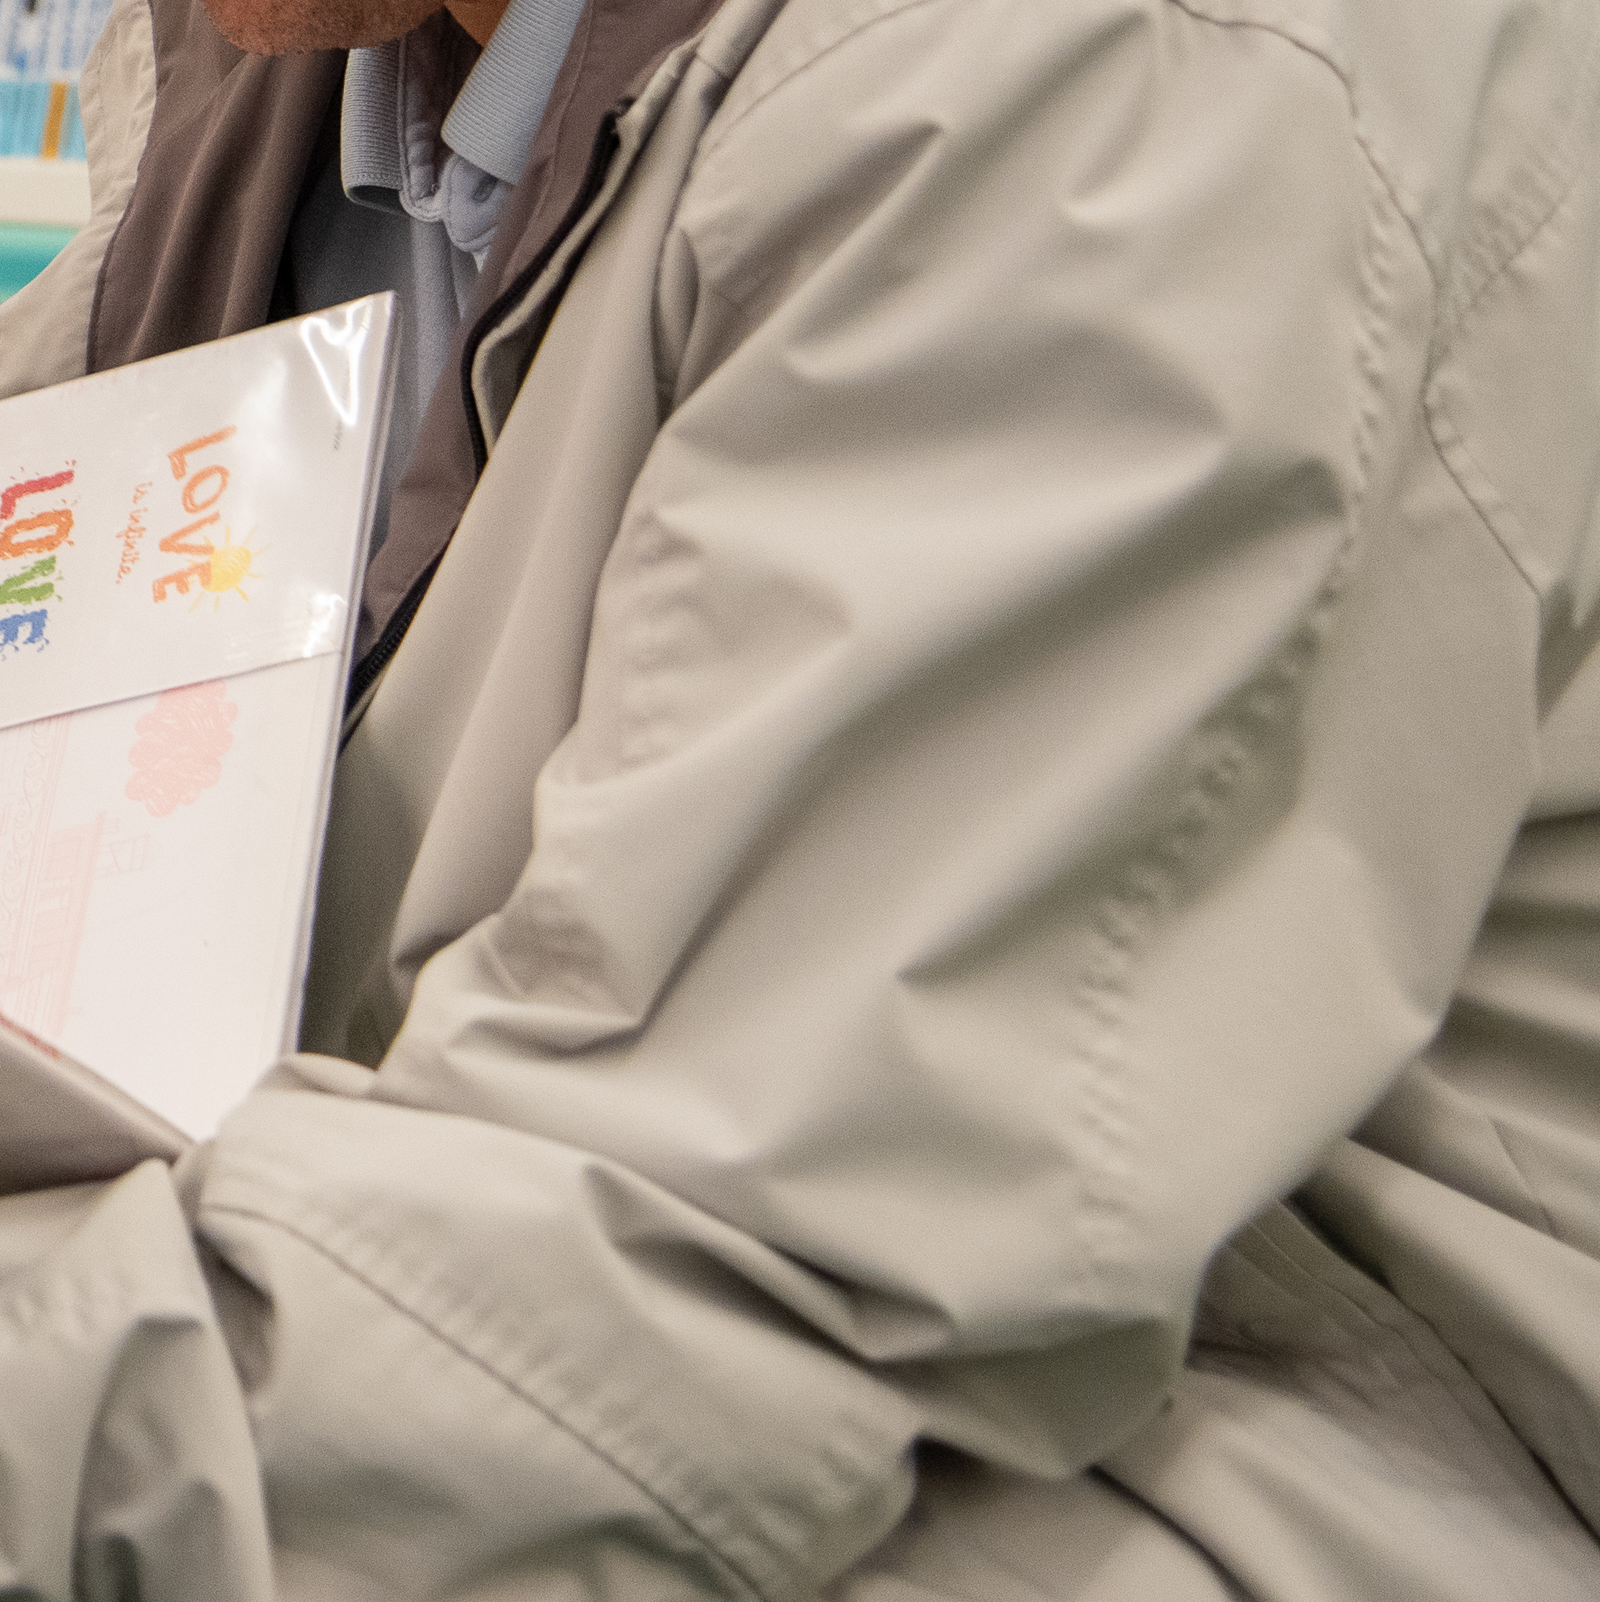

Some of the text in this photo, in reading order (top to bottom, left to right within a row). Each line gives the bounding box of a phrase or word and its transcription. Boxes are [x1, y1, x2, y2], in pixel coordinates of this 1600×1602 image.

[115, 482, 153, 585] is infinite.
[152, 425, 238, 603] LOVE
